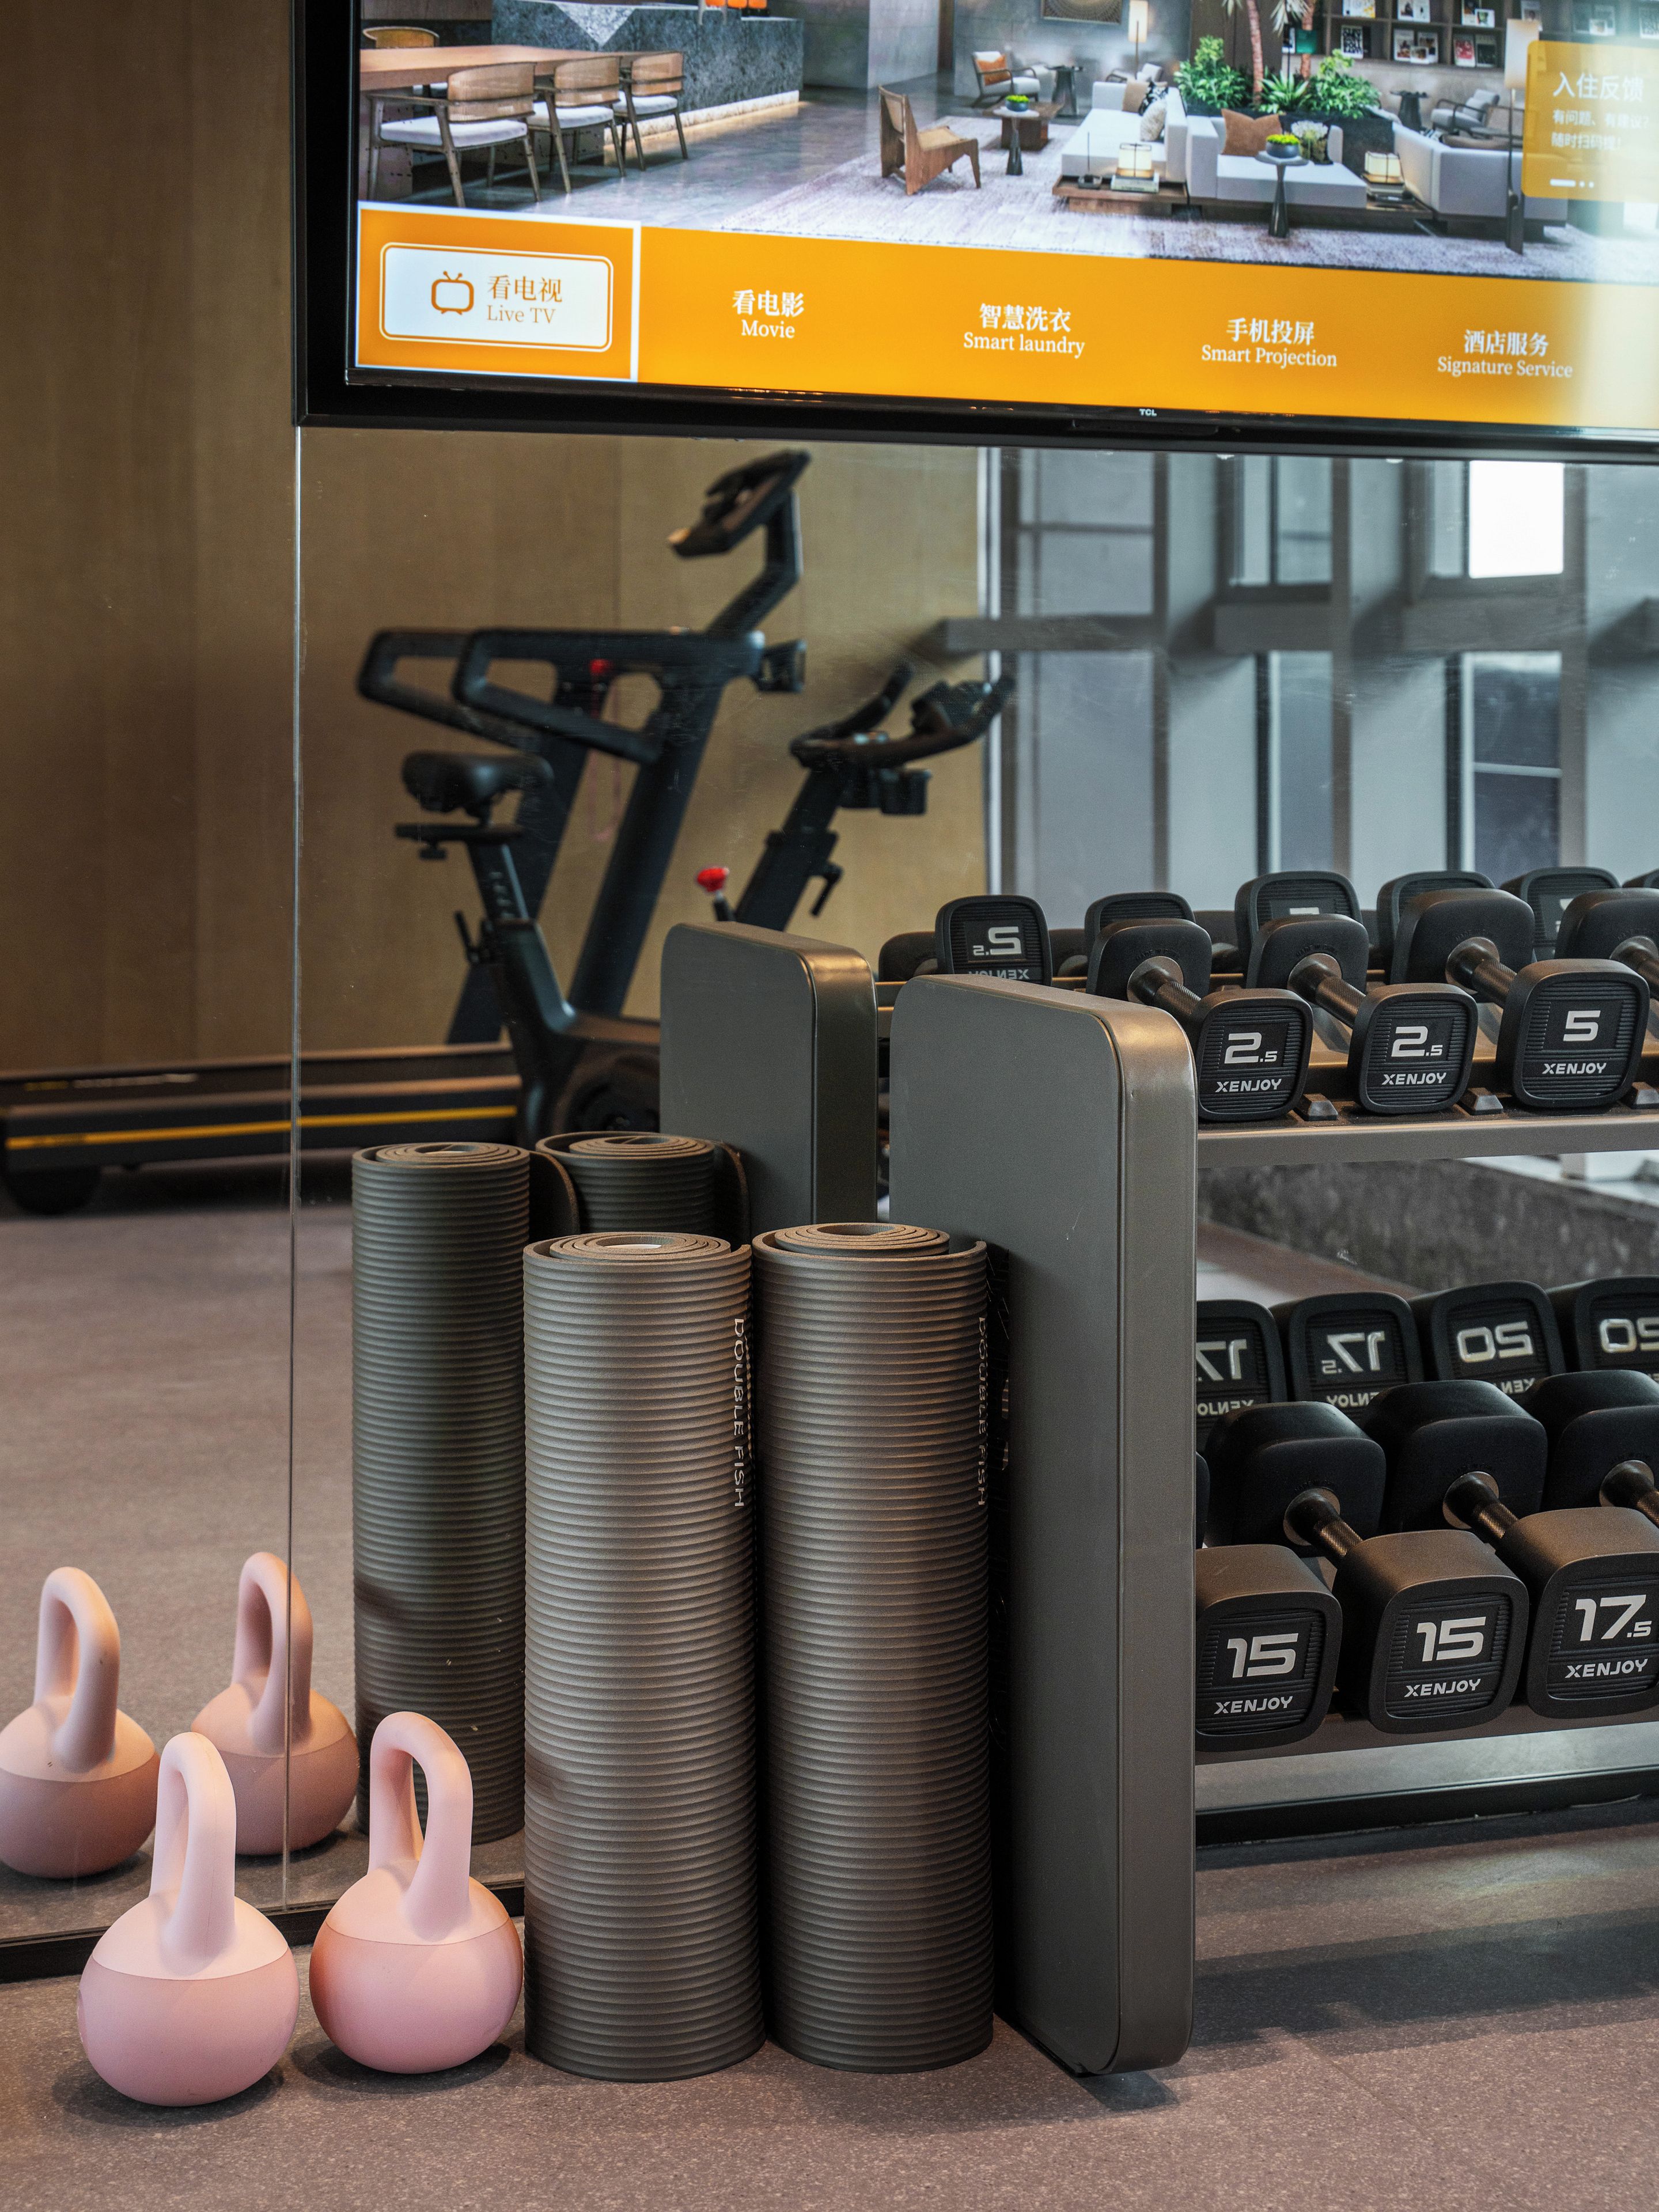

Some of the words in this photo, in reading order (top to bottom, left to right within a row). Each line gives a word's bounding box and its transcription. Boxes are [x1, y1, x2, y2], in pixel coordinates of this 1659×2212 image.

[1553, 72, 1643, 102] 入住反馈
[487, 274, 563, 303] 看电视
[486, 304, 525, 323] Live
[529, 307, 556, 324] TV
[732, 289, 805, 318] 看电影
[979, 303, 1072, 332] 智慧洗衣
[741, 319, 796, 339] Movie
[1226, 317, 1315, 346] 手机投屏
[1464, 329, 1548, 356] 酒店服务
[963, 331, 1016, 350] Smart
[1019, 334, 1085, 359] laundry
[1201, 344, 1252, 363] Smart
[1255, 346, 1338, 369] Projection
[1437, 355, 1513, 378] Signature
[1516, 359, 1573, 378] Service
[1139, 408, 1157, 417] TCL
[1563, 1010, 1601, 1041] 5
[1224, 1032, 1278, 1065] 2.5
[1391, 1026, 1443, 1058] 2.5
[1382, 1073, 1447, 1086] XENJOY
[1542, 1062, 1607, 1075] XENJOY
[1215, 1079, 1282, 1093] XENJOY
[734, 1319, 744, 1435] DOUBLE
[734, 1446, 744, 1506] FISH
[1575, 1594, 1652, 1642] 17.5
[1416, 1616, 1487, 1662] 15
[1227, 1633, 1299, 1678] 15
[1565, 1658, 1648, 1679] XENJOY
[1404, 1679, 1481, 1698] XENJOY
[1214, 1696, 1293, 1715] XENJOY
